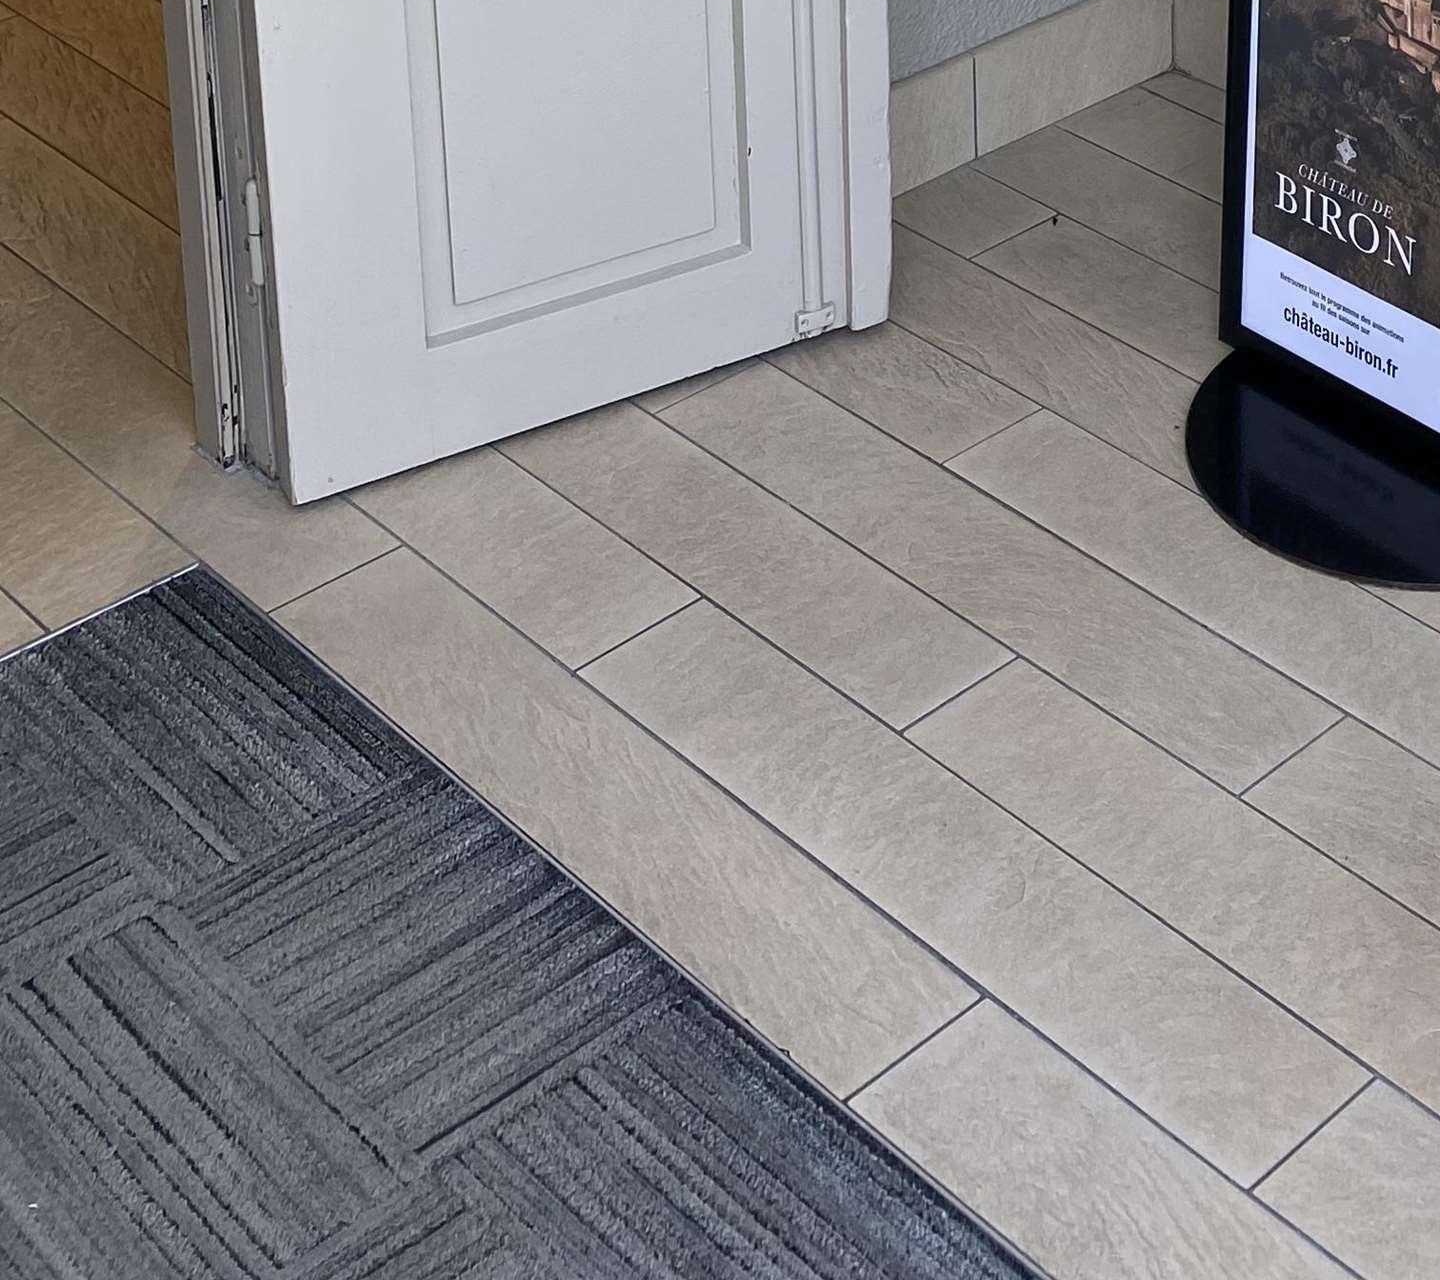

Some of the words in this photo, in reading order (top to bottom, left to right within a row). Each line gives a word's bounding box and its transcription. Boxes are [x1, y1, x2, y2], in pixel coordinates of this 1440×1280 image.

[1298, 163, 1367, 207] CHÂTEAU
[1371, 198, 1394, 220] DE
[1274, 170, 1417, 276] BIRON
[1327, 296, 1360, 320] programme
[1360, 313, 1372, 327] des
[1327, 307, 1338, 318] des
[1360, 324, 1371, 337] sur
[1283, 306, 1399, 379] château-biron.fr
